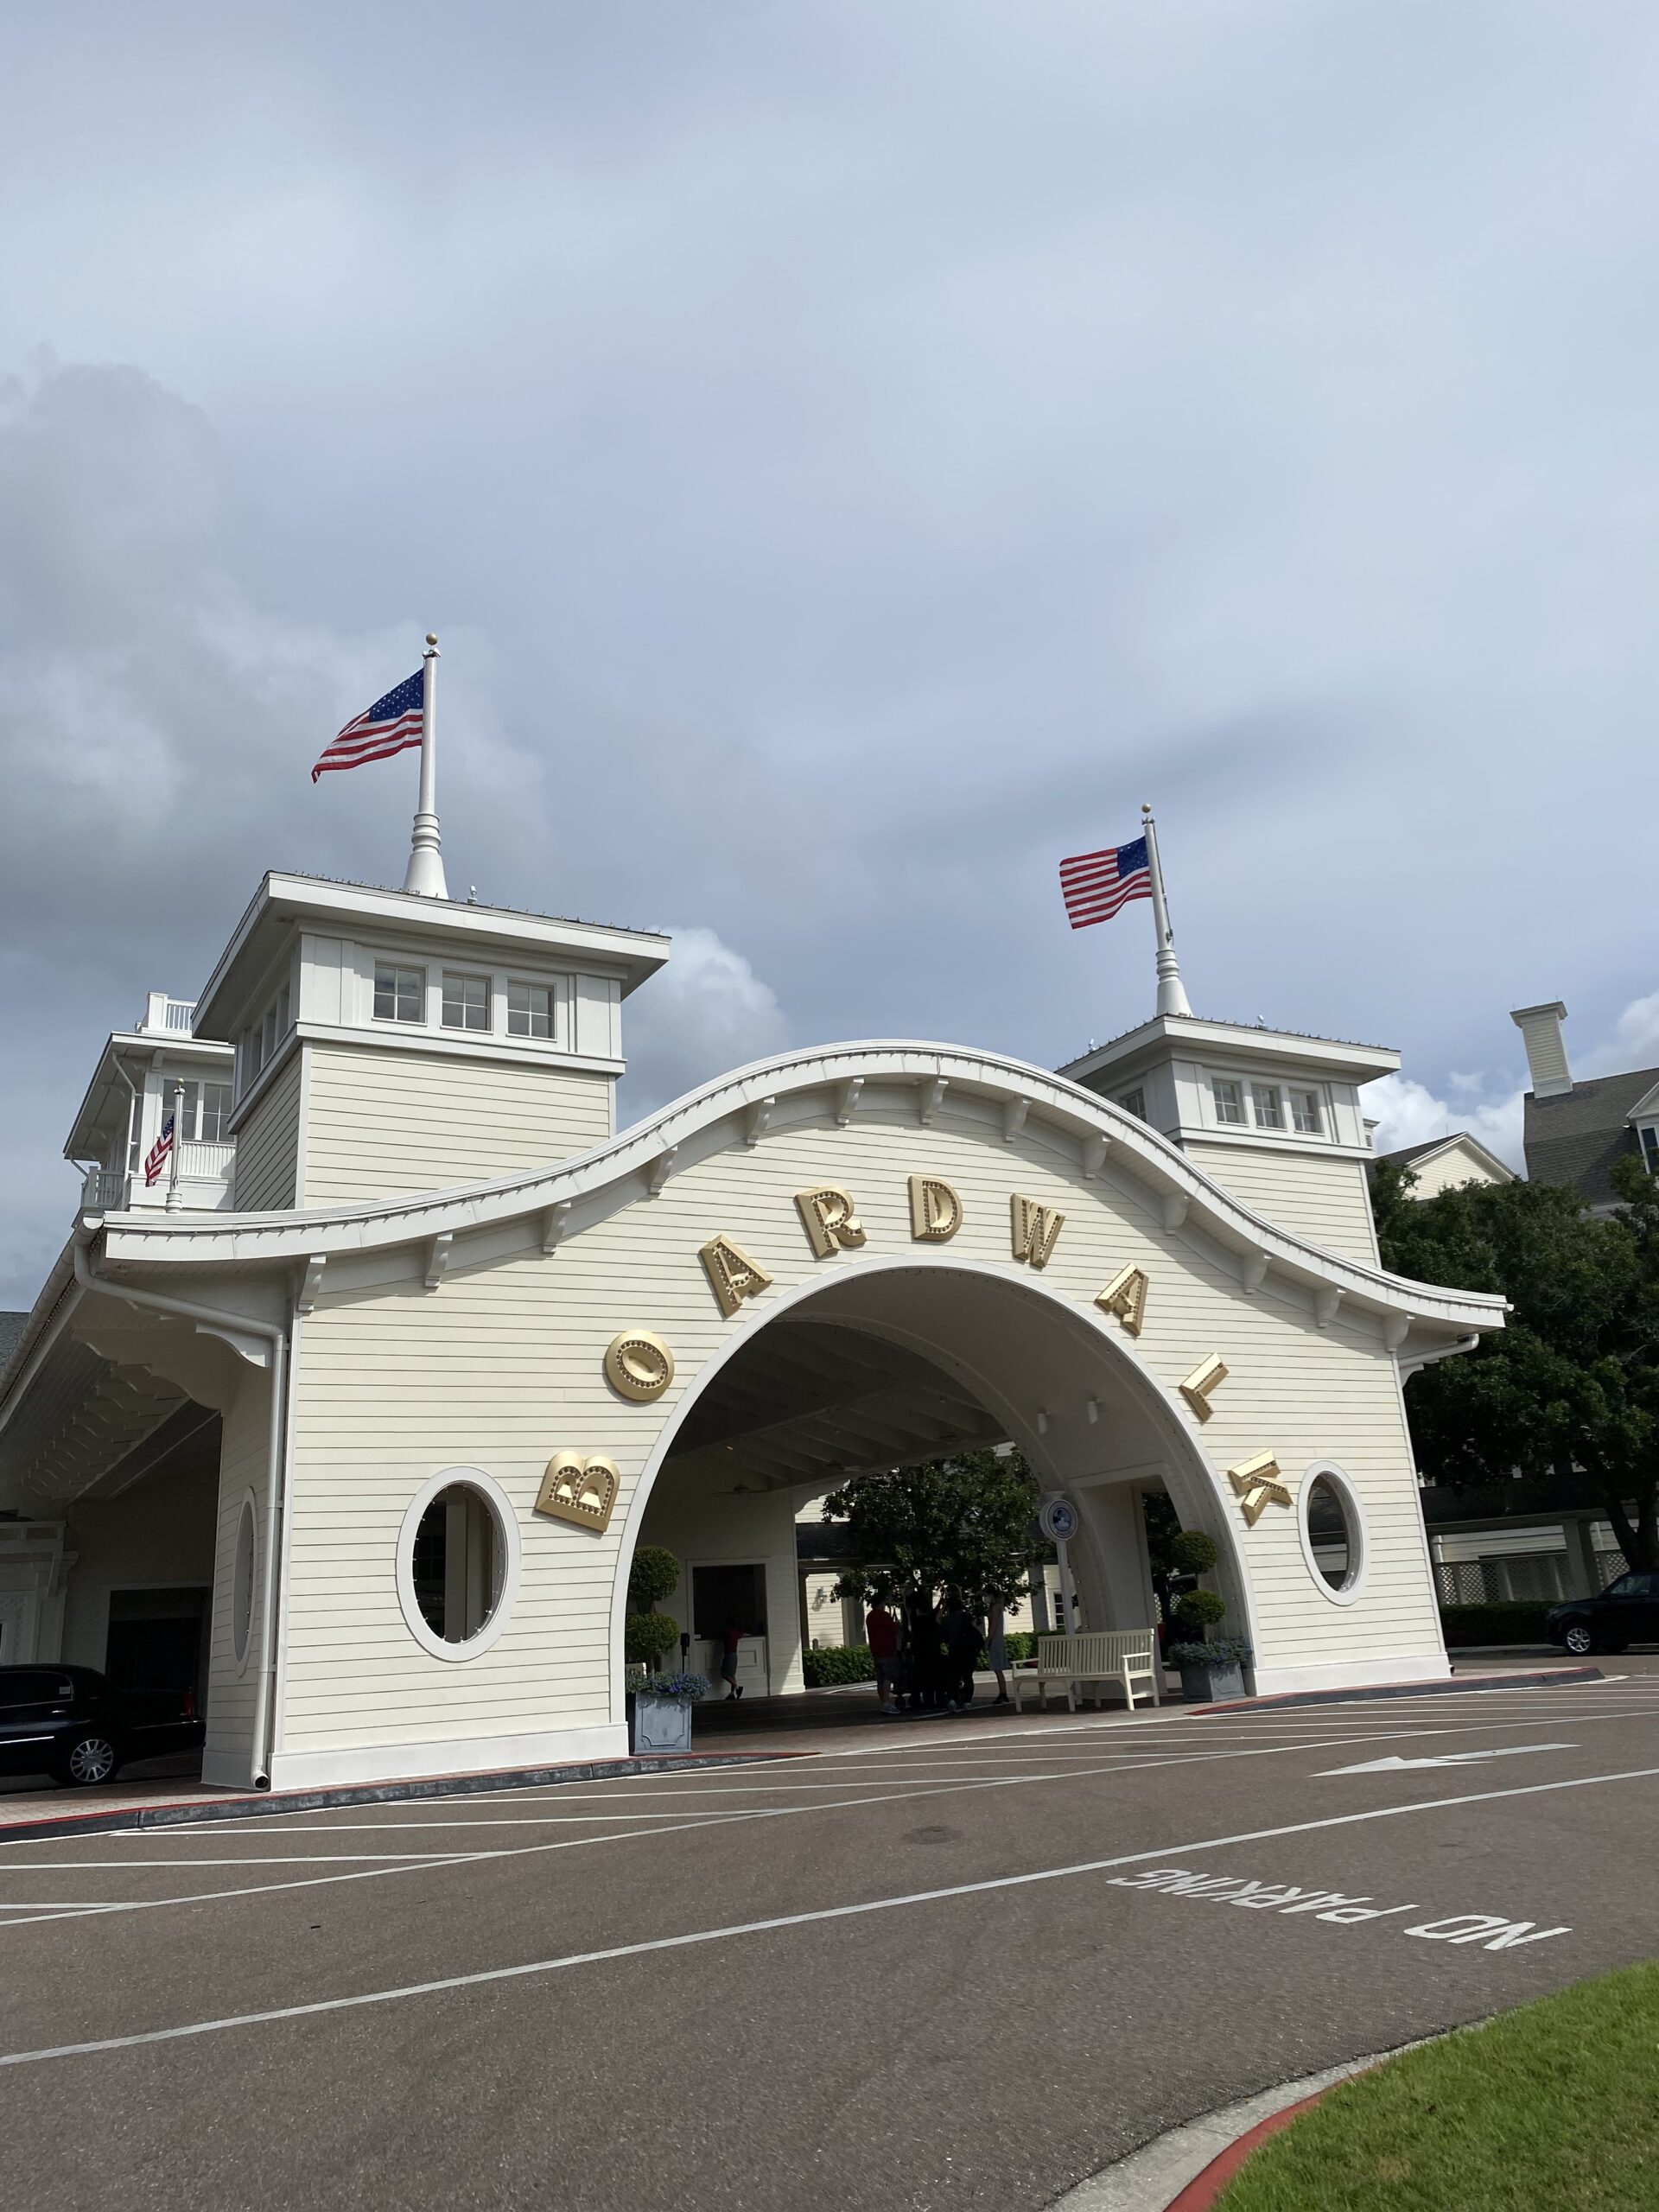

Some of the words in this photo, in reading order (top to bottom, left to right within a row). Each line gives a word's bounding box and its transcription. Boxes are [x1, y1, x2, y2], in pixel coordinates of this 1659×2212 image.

[534, 1173, 1294, 1533] BOARDWALK
[1106, 1868, 1421, 1924] PARKING
[1403, 1913, 1573, 1951] NO
